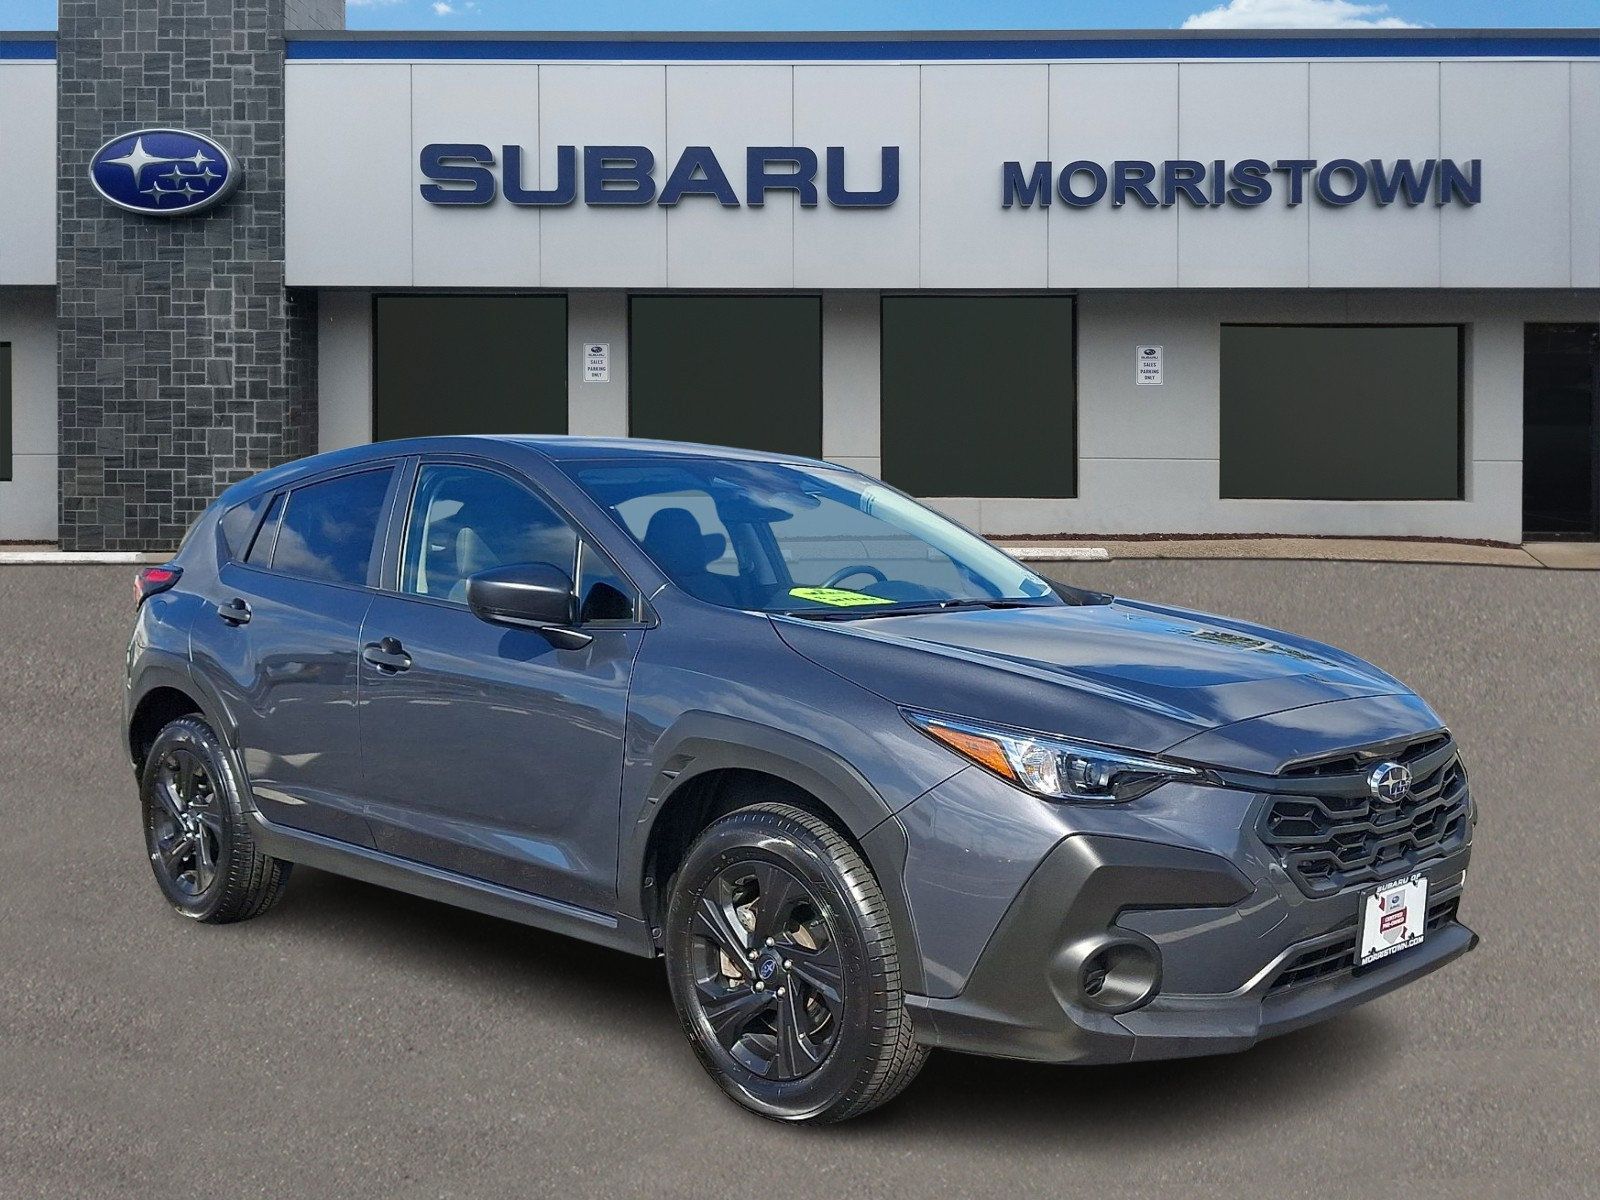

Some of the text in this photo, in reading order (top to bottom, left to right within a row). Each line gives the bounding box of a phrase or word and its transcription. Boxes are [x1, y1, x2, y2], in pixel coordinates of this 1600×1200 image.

[420, 143, 900, 207] SUBARU
[1001, 159, 1482, 208] MORRISTOWN
[1377, 873, 1422, 892] SUBARU OF
[1361, 936, 1424, 965] MORRISTOWN.COM
